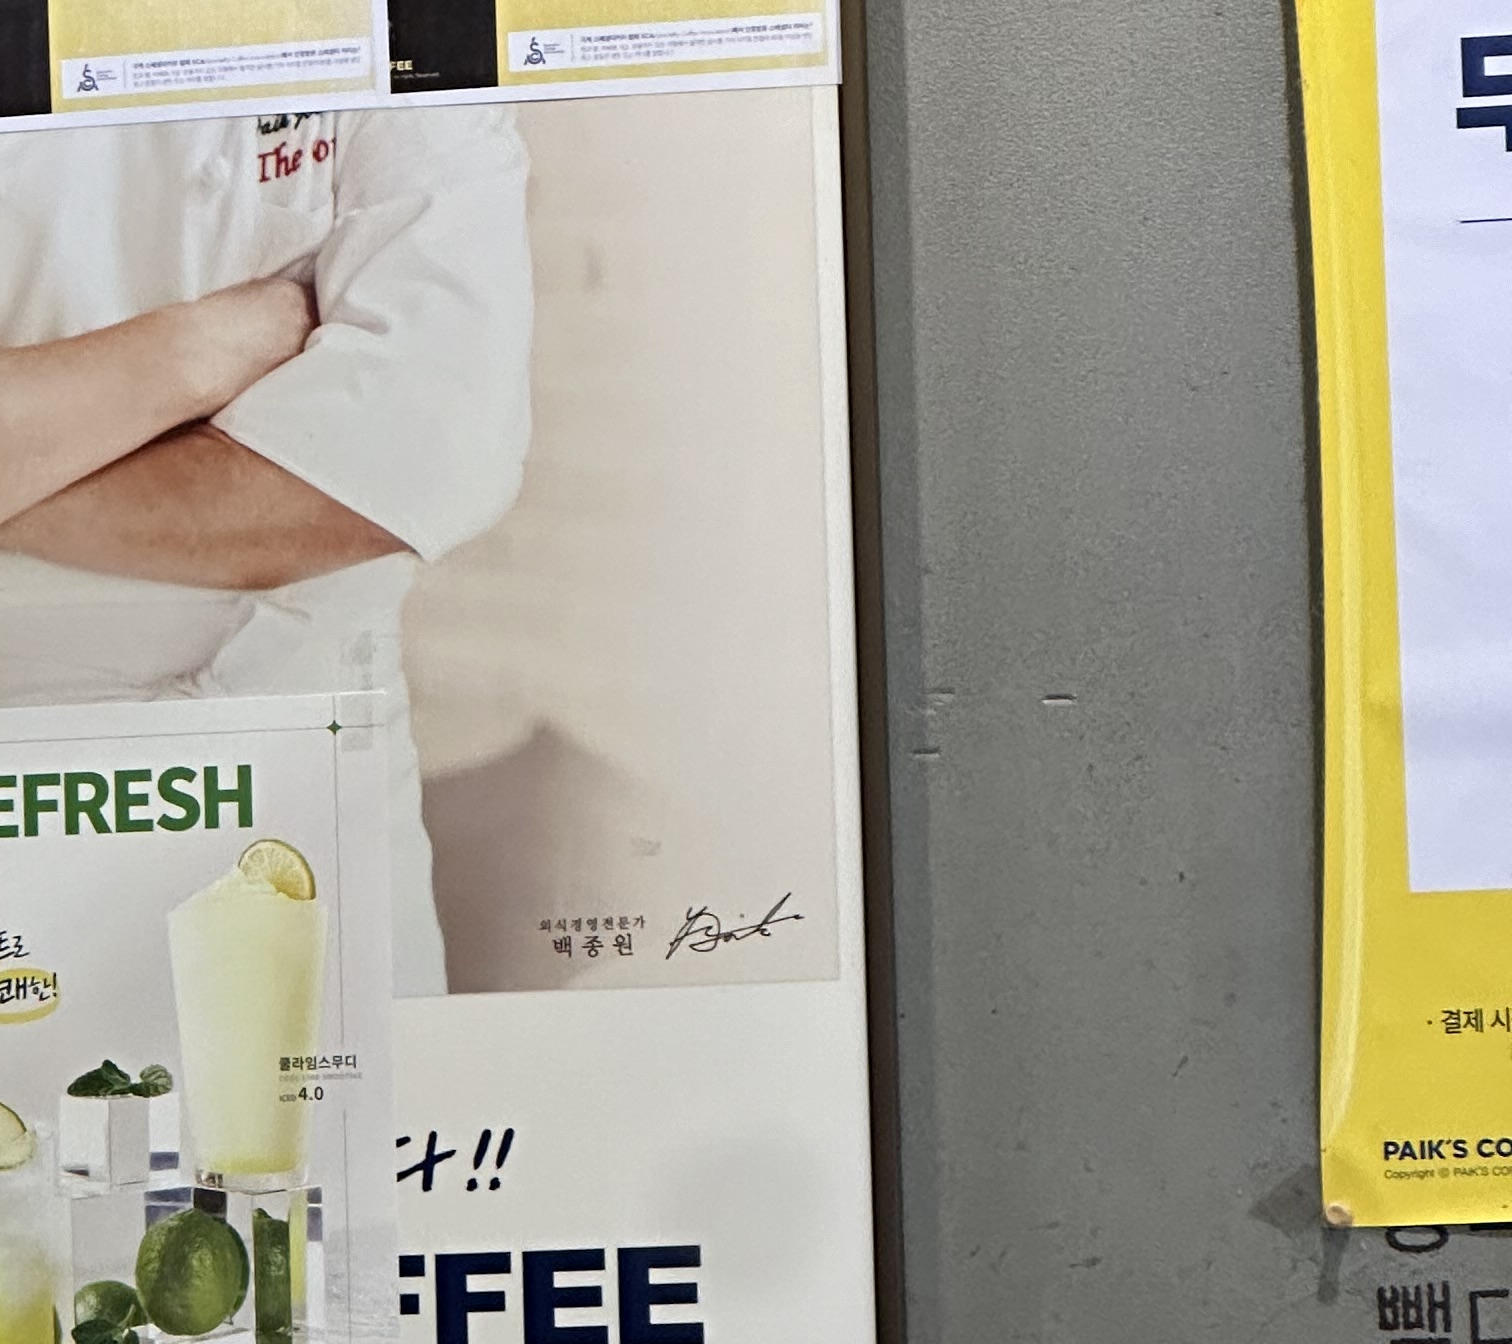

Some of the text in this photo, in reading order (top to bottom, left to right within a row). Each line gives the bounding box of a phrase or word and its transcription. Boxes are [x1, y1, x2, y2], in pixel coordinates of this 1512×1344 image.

[1490, 1006, 1511, 1033] 시
[298, 1086, 324, 1101] 4.0
[1383, 1138, 1468, 1162] PAIK'S
